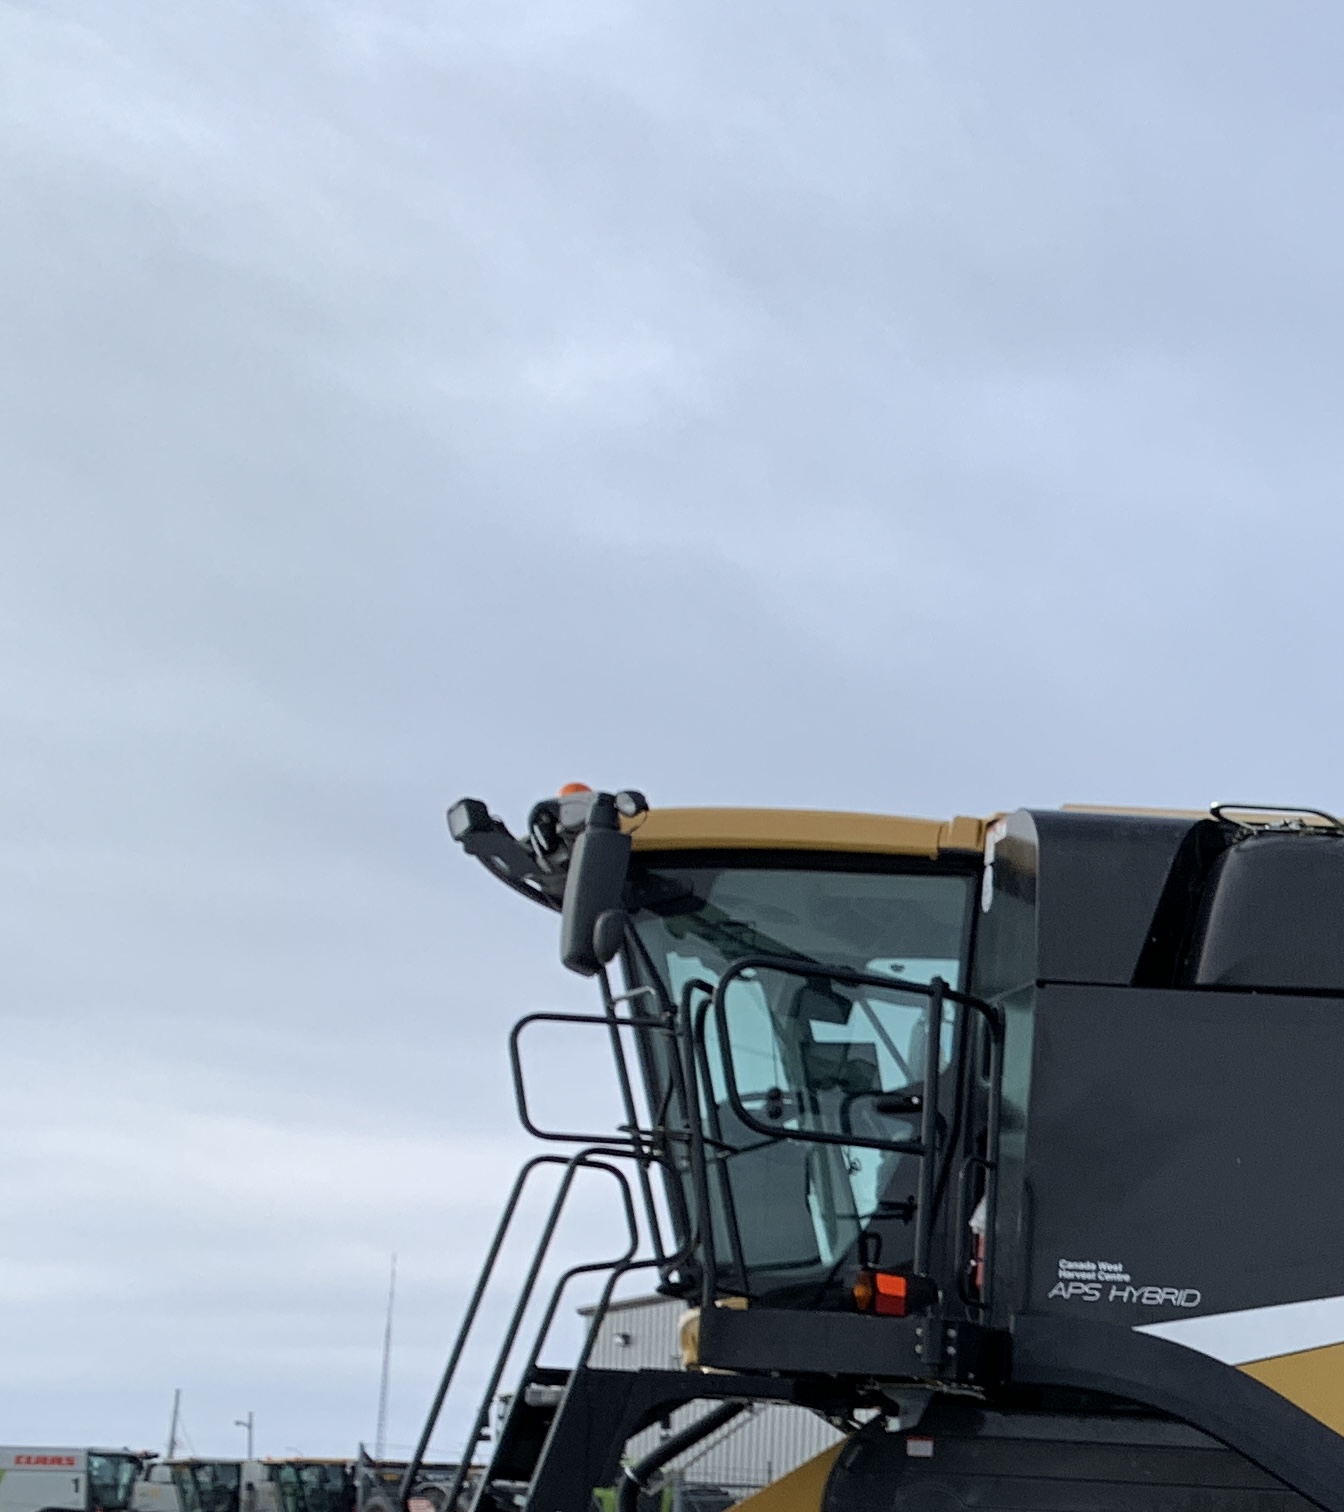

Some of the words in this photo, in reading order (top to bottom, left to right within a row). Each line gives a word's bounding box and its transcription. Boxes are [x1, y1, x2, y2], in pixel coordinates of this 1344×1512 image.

[1058, 1259, 1096, 1270] Canada
[1097, 1261, 1123, 1272] West
[1058, 1269, 1096, 1281] Harvest
[1097, 1271, 1131, 1283] Centre
[1047, 1281, 1102, 1301] APS
[1108, 1285, 1201, 1308] HYBRID
[14, 1455, 75, 1466] CLAAS
